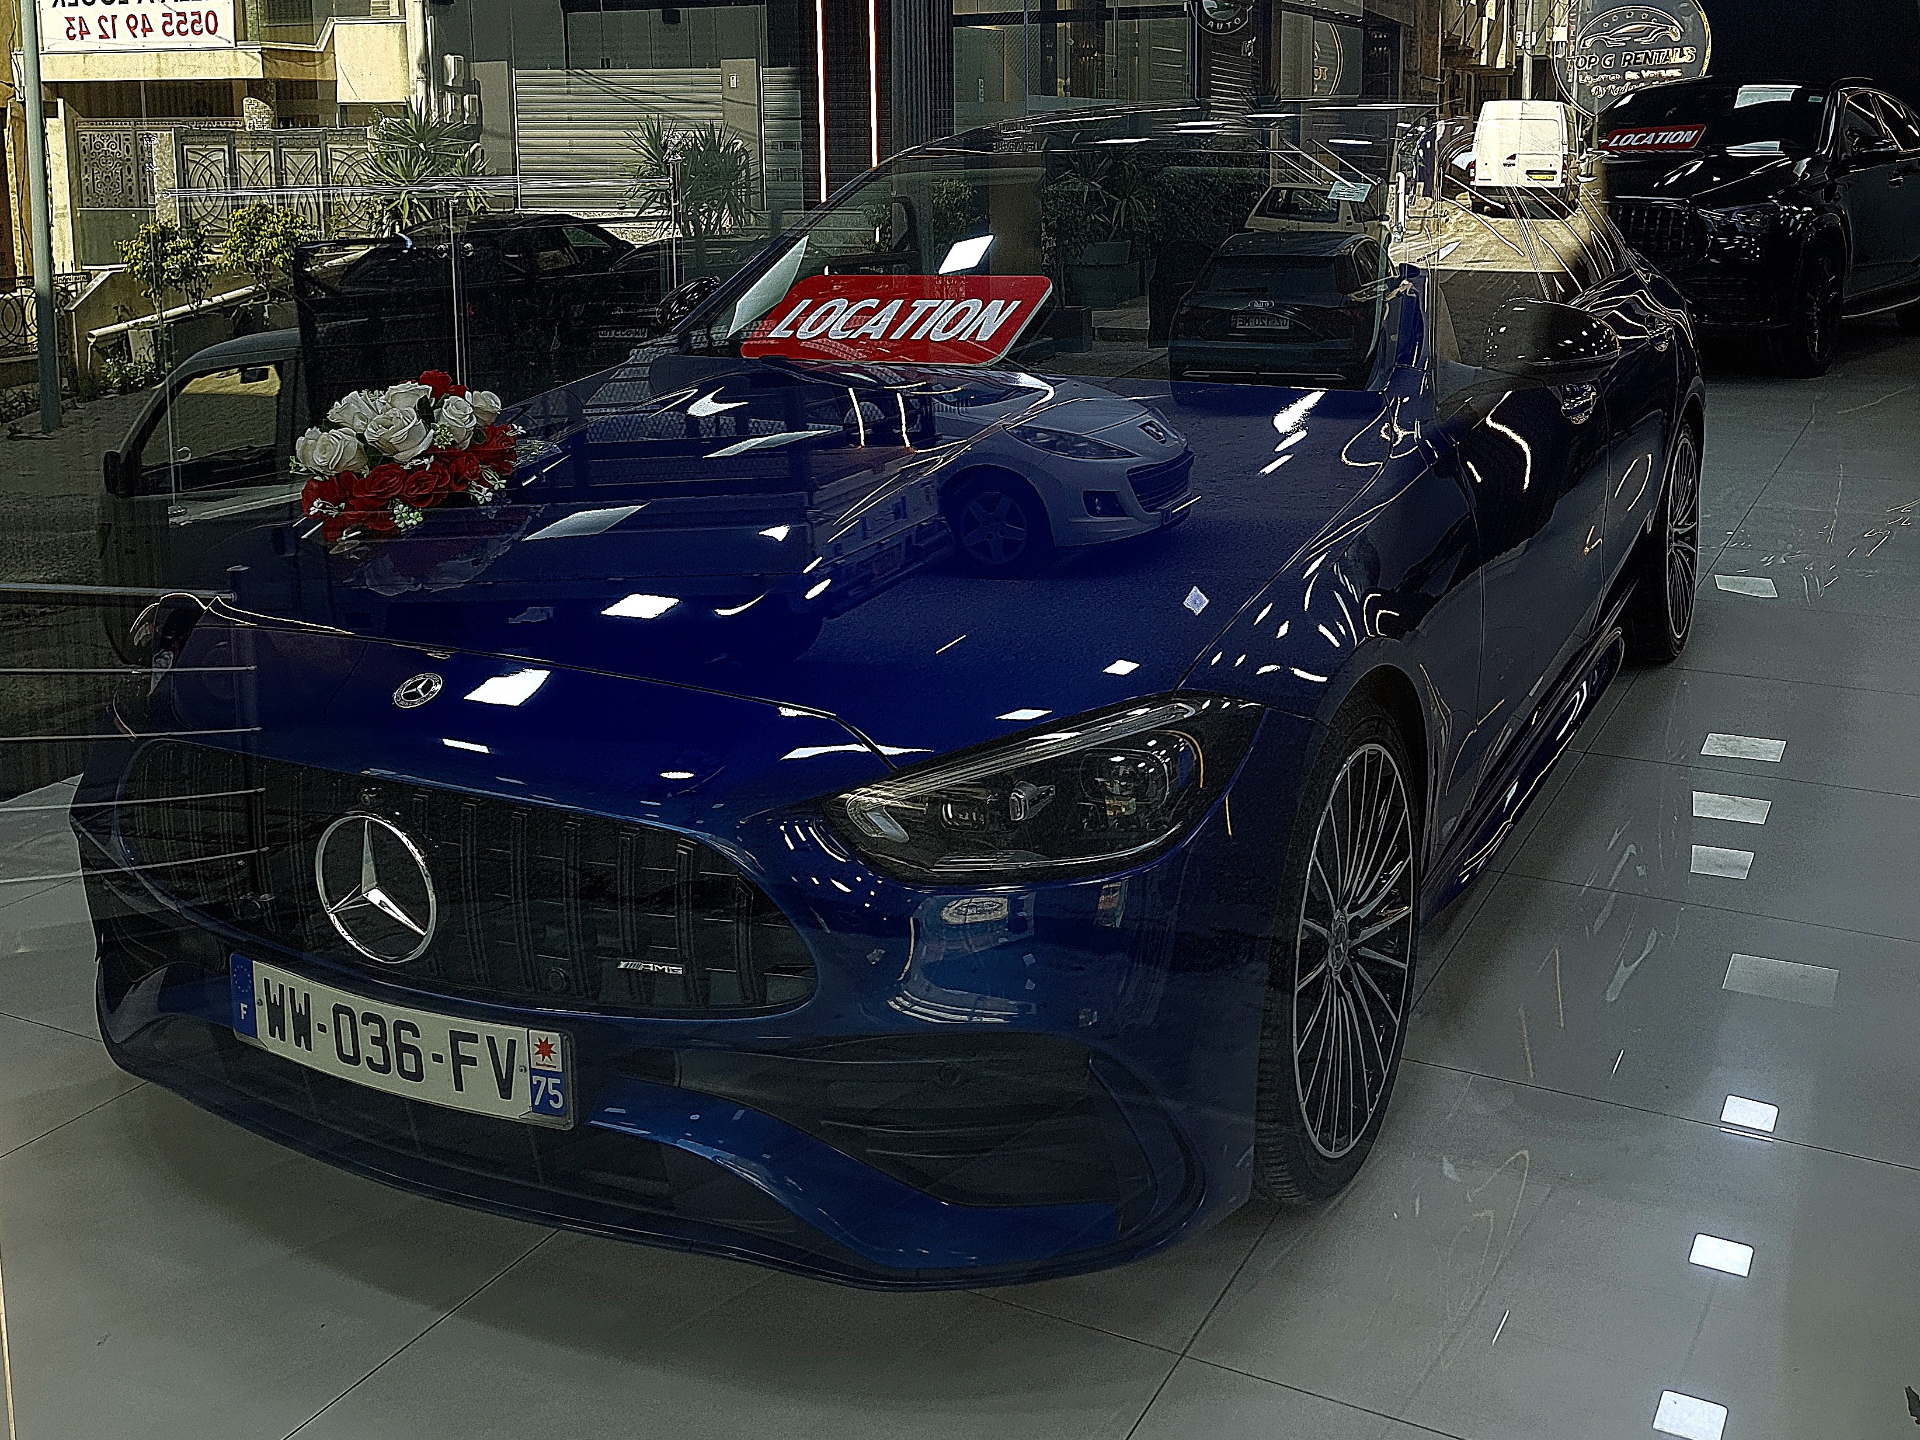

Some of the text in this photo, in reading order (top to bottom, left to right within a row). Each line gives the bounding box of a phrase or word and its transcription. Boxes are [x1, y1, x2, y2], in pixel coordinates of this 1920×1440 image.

[1207, 17, 1241, 30] AUTO
[1566, 46, 1697, 72] TOP G RENTALS
[1608, 129, 1699, 147] LOCATION
[766, 298, 1022, 342] LOCATION
[638, 962, 683, 975] AMG
[239, 1002, 248, 1021] F
[263, 977, 518, 1101] WW-036-FV
[532, 1075, 564, 1109] 75
